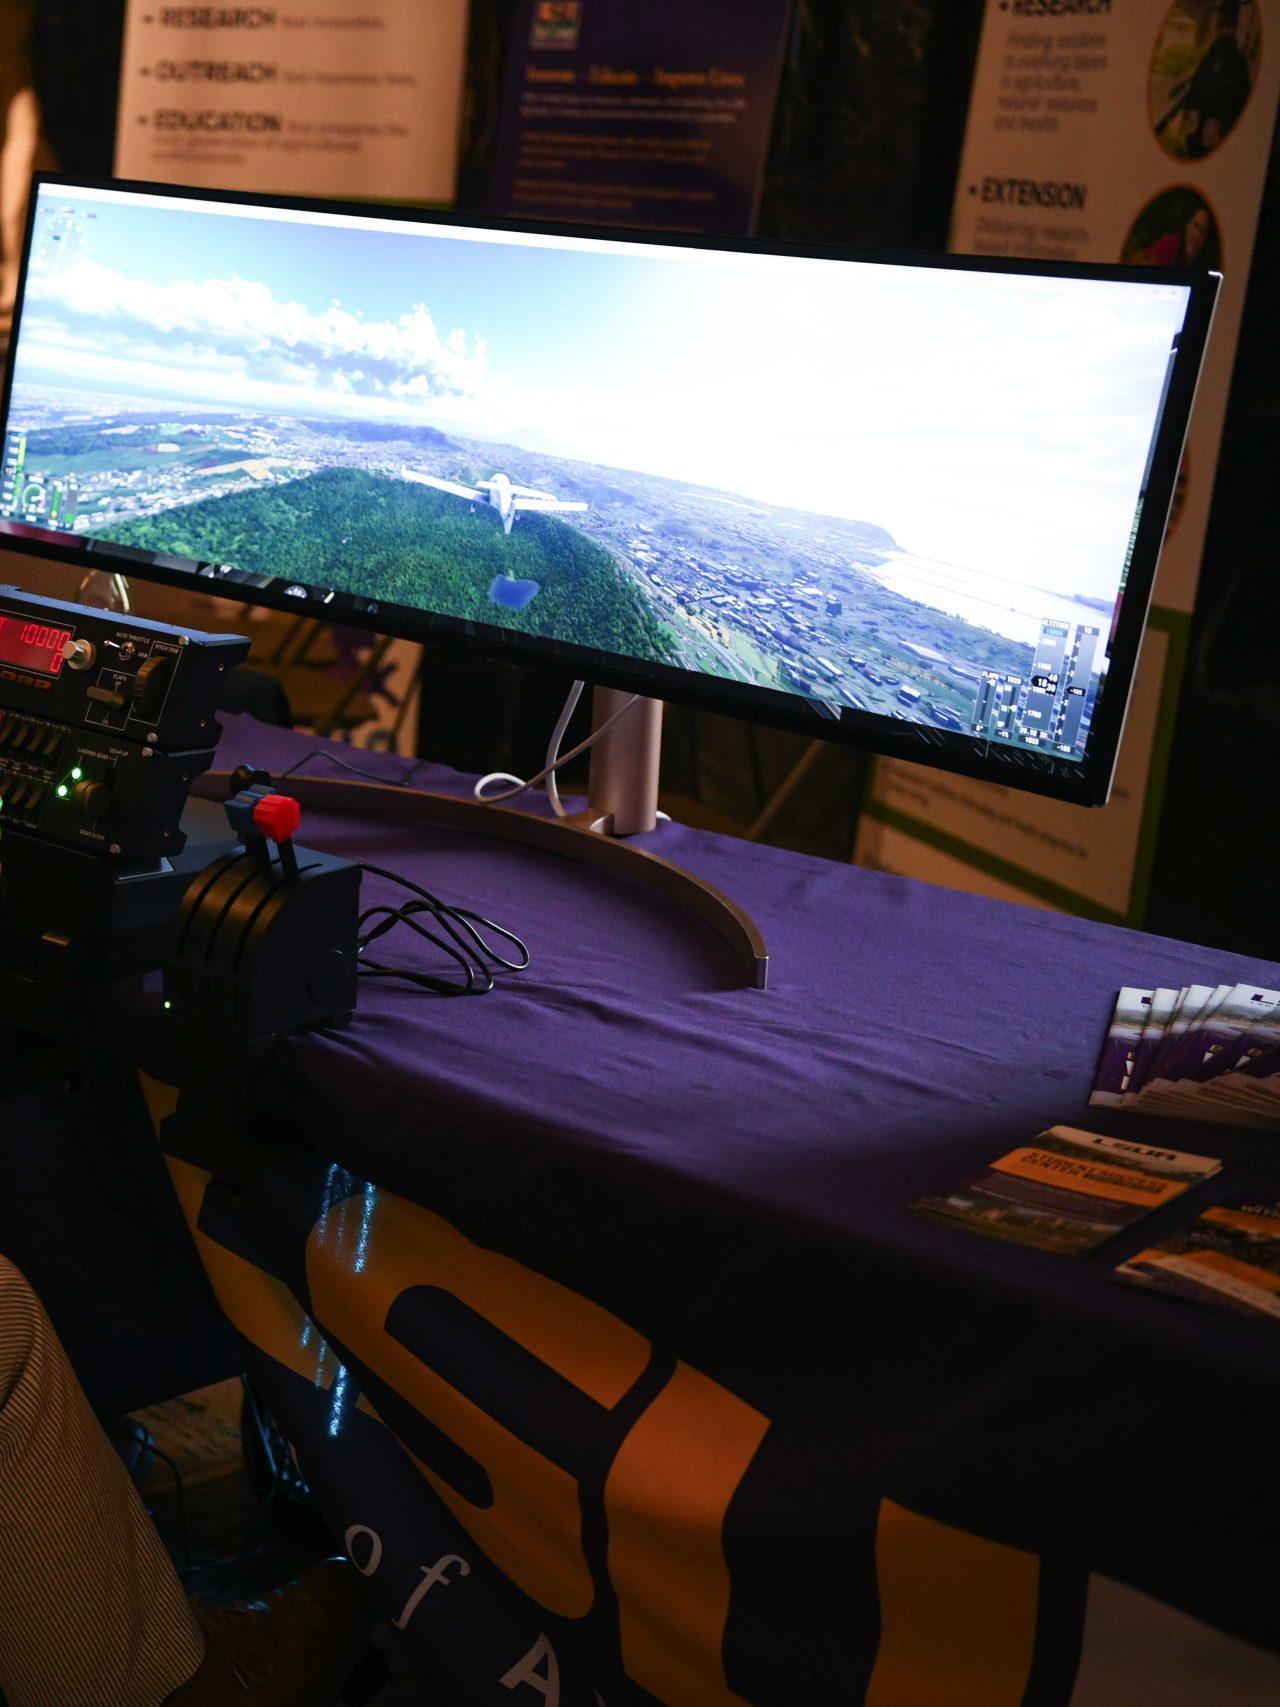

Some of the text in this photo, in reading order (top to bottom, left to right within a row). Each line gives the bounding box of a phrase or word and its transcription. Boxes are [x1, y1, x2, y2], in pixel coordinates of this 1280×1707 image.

[161, 6, 276, 29] RESEARCH
[157, 60, 277, 83] OUTREACH
[153, 108, 282, 132] EDUCATION
[980, 176, 1087, 209] EXTENSION
[21, 624, 71, 650] 10000
[344, 1524, 470, 1629] of
